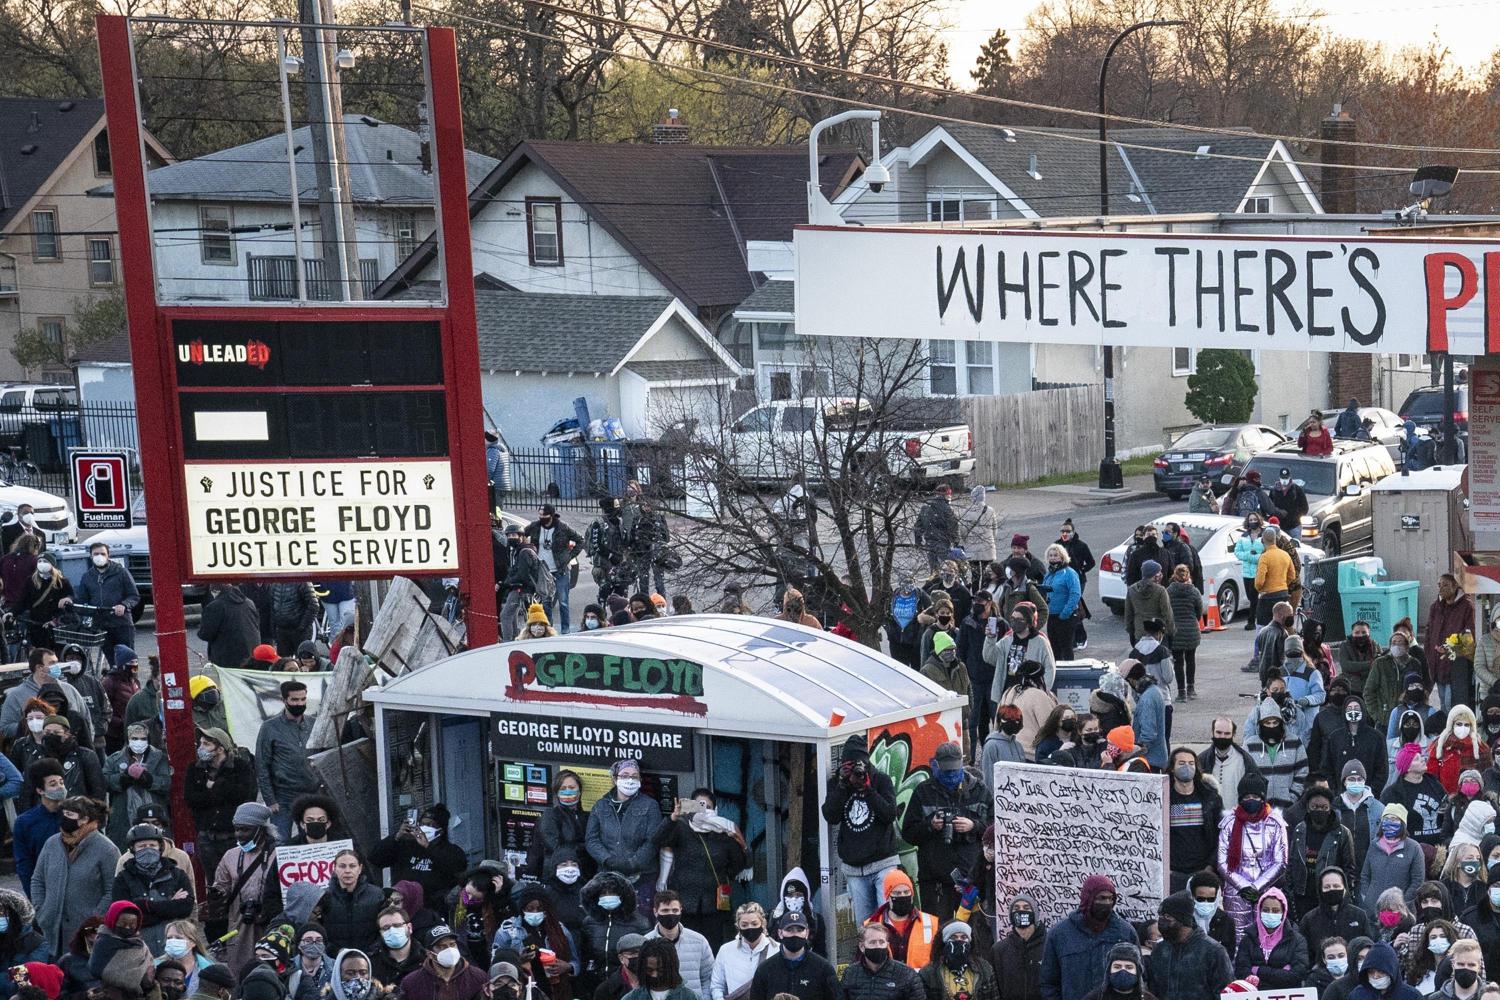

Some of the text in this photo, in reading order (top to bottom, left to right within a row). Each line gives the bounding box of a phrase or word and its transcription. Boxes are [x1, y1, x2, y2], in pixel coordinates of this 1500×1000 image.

[936, 243, 1127, 328] WHERE
[1154, 244, 1387, 346] THERE'S
[178, 342, 270, 365] UNLEADED
[1472, 406, 1494, 414] SELF
[1472, 415, 1500, 424] SERVE
[226, 470, 407, 497] JUSTICE FOR
[83, 513, 124, 521] Fuelman
[206, 504, 432, 534] GEORGE FLOYD
[207, 541, 319, 568] JUSTICE
[498, 720, 683, 749] GEORGE FLOYD SQUARE
[537, 740, 643, 760] COMMUNITY INFO
[1020, 778, 1048, 798] THE
[1131, 786, 1162, 809] OUR
[996, 796, 1062, 819] DEMANDS
[1061, 802, 1093, 823] FOR
[997, 816, 1026, 835] THE
[1071, 839, 1101, 854] FOR
[1017, 869, 1044, 884] THE
[1120, 874, 1151, 891] OUR
